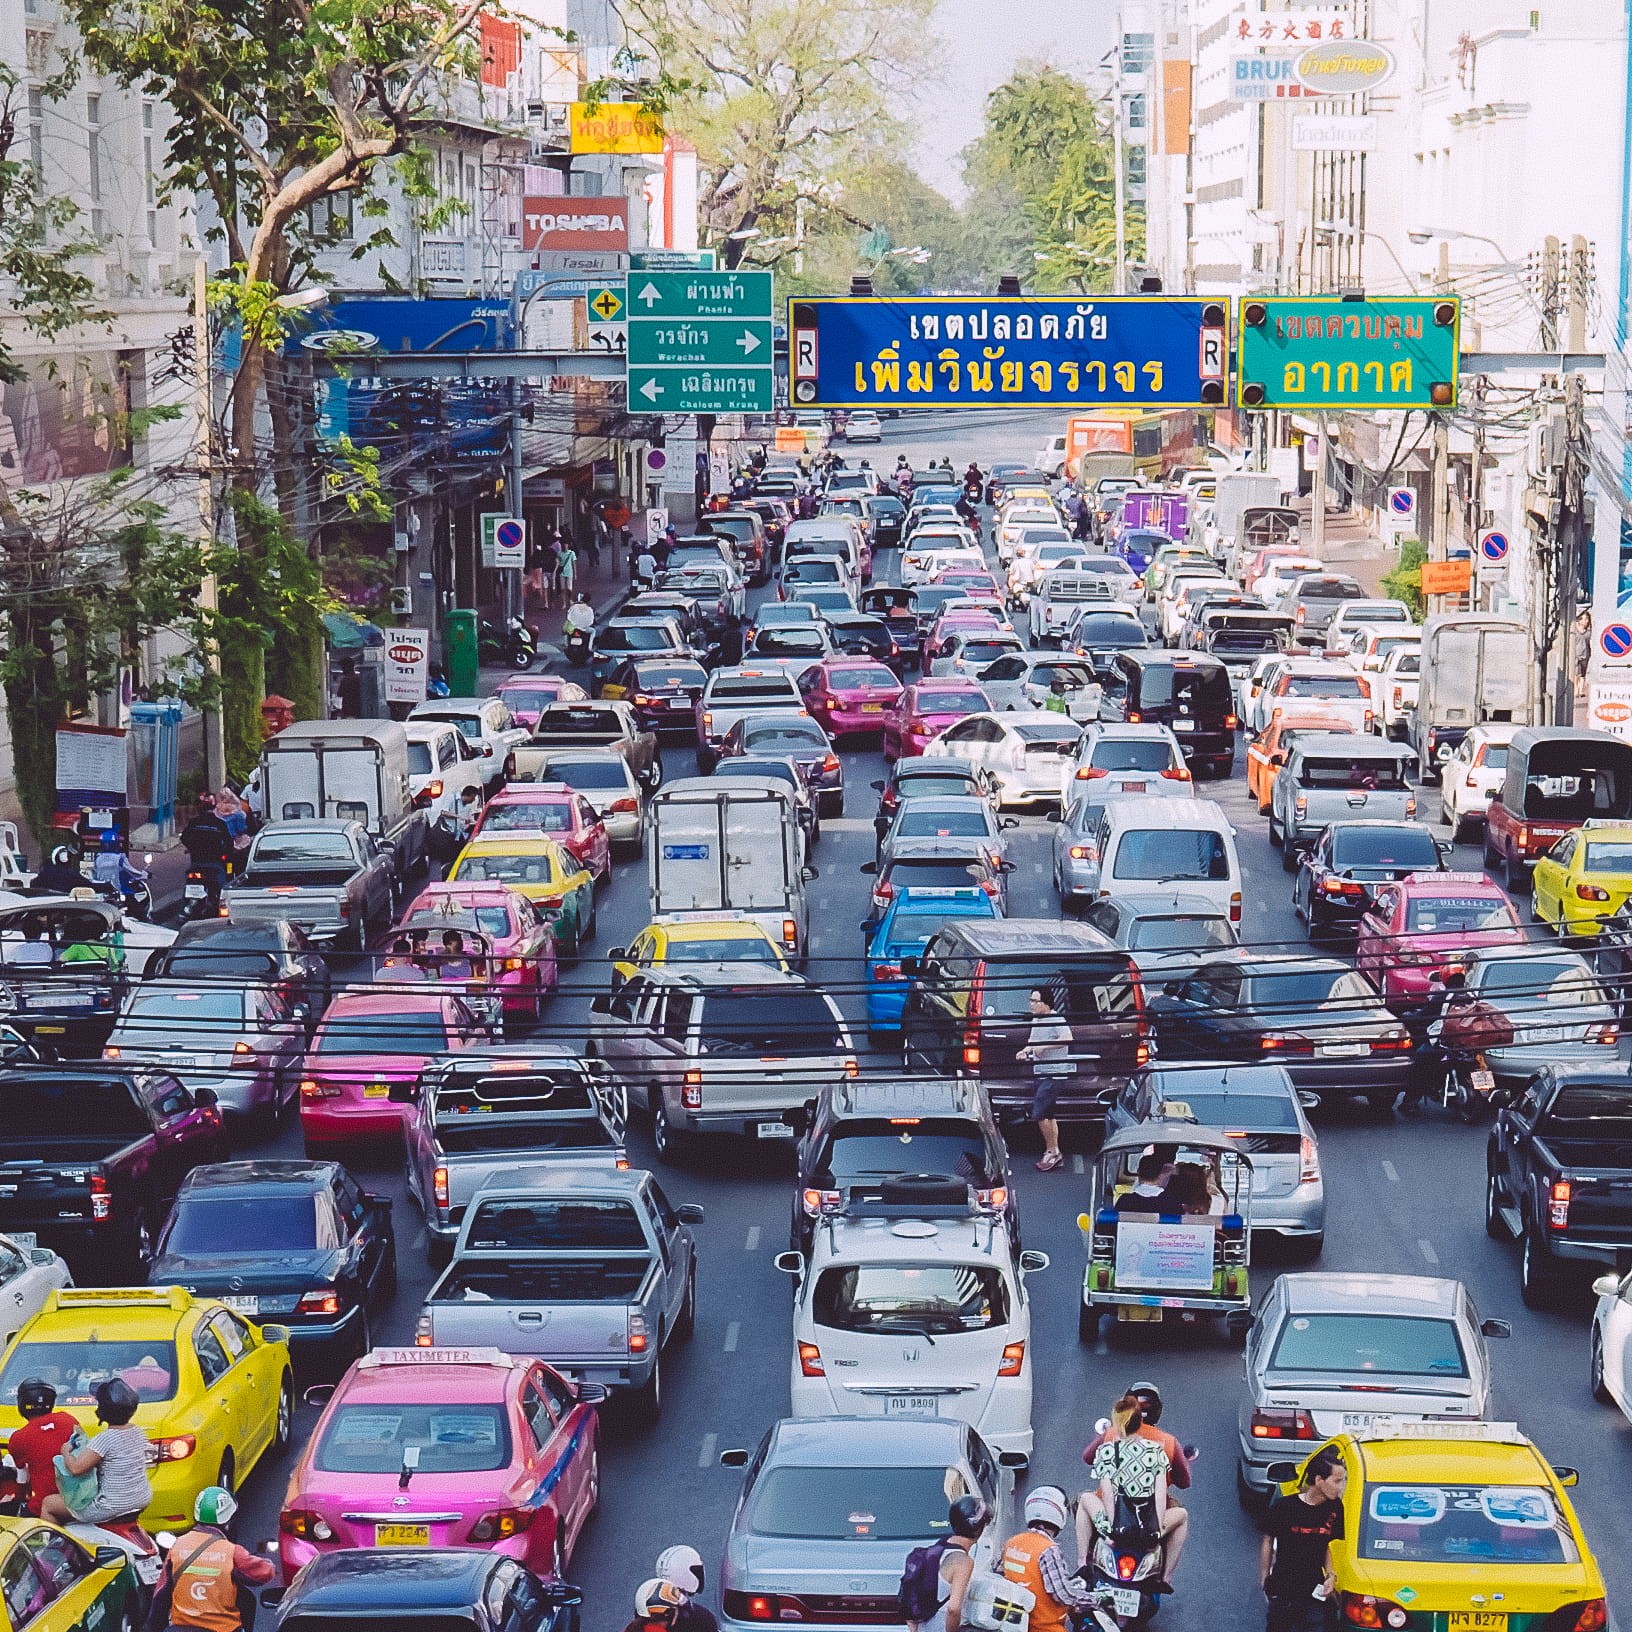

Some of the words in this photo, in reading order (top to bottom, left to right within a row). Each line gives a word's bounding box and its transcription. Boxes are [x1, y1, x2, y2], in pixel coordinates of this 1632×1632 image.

[1236, 86, 1271, 98] HOTEL
[562, 256, 605, 270] Tasaki
[686, 276, 745, 300] ผ่านฟ้า
[910, 304, 1108, 341] เขตปลอดภัย
[654, 324, 710, 347] วรจักร
[855, 341, 1164, 393] เพิ่มวินัยจราจร
[1284, 358, 1414, 394] อากาศ
[681, 371, 756, 398] เฉลิมกรุง
